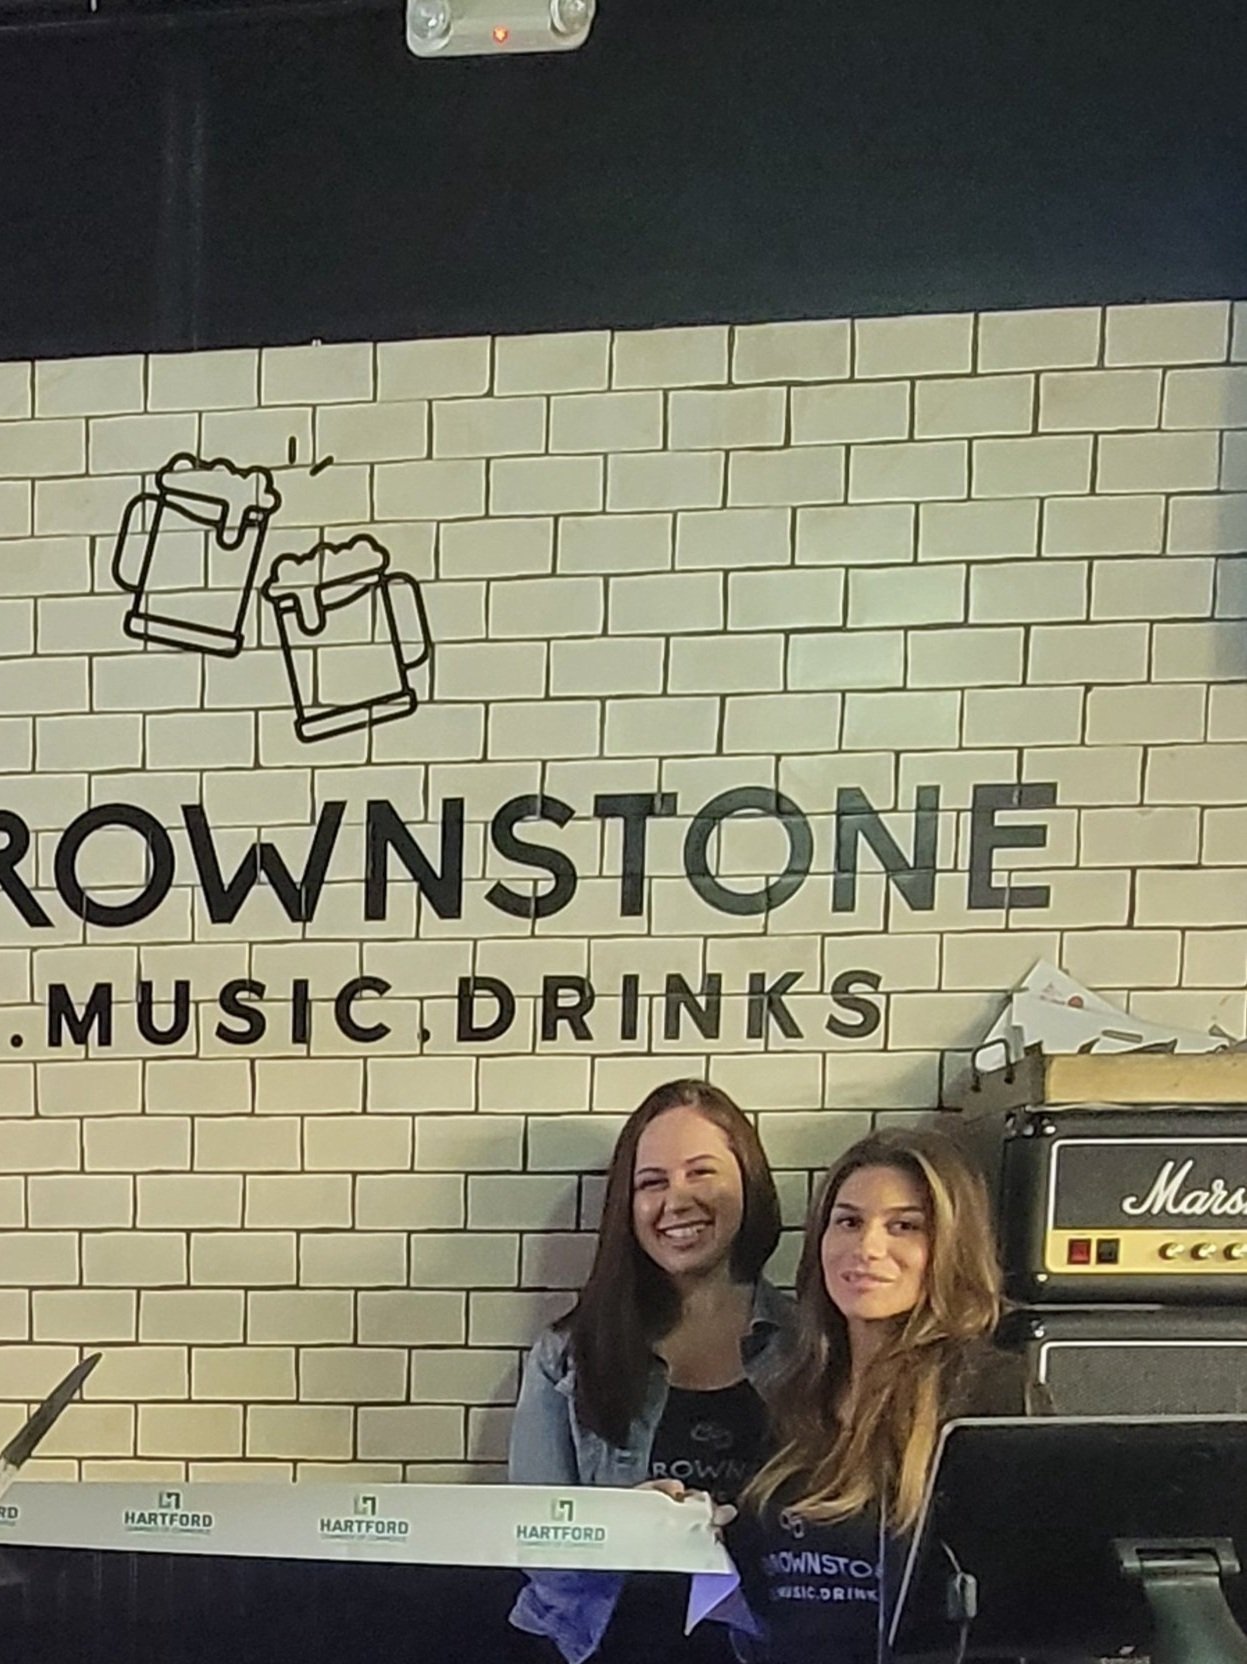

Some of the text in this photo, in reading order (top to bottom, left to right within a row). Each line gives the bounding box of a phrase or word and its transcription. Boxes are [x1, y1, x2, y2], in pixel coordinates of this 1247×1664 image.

[124, 1511, 213, 1528] HARTFORD
[319, 1518, 409, 1535] HARTFORD
[516, 1525, 606, 1542] HARTFORD
